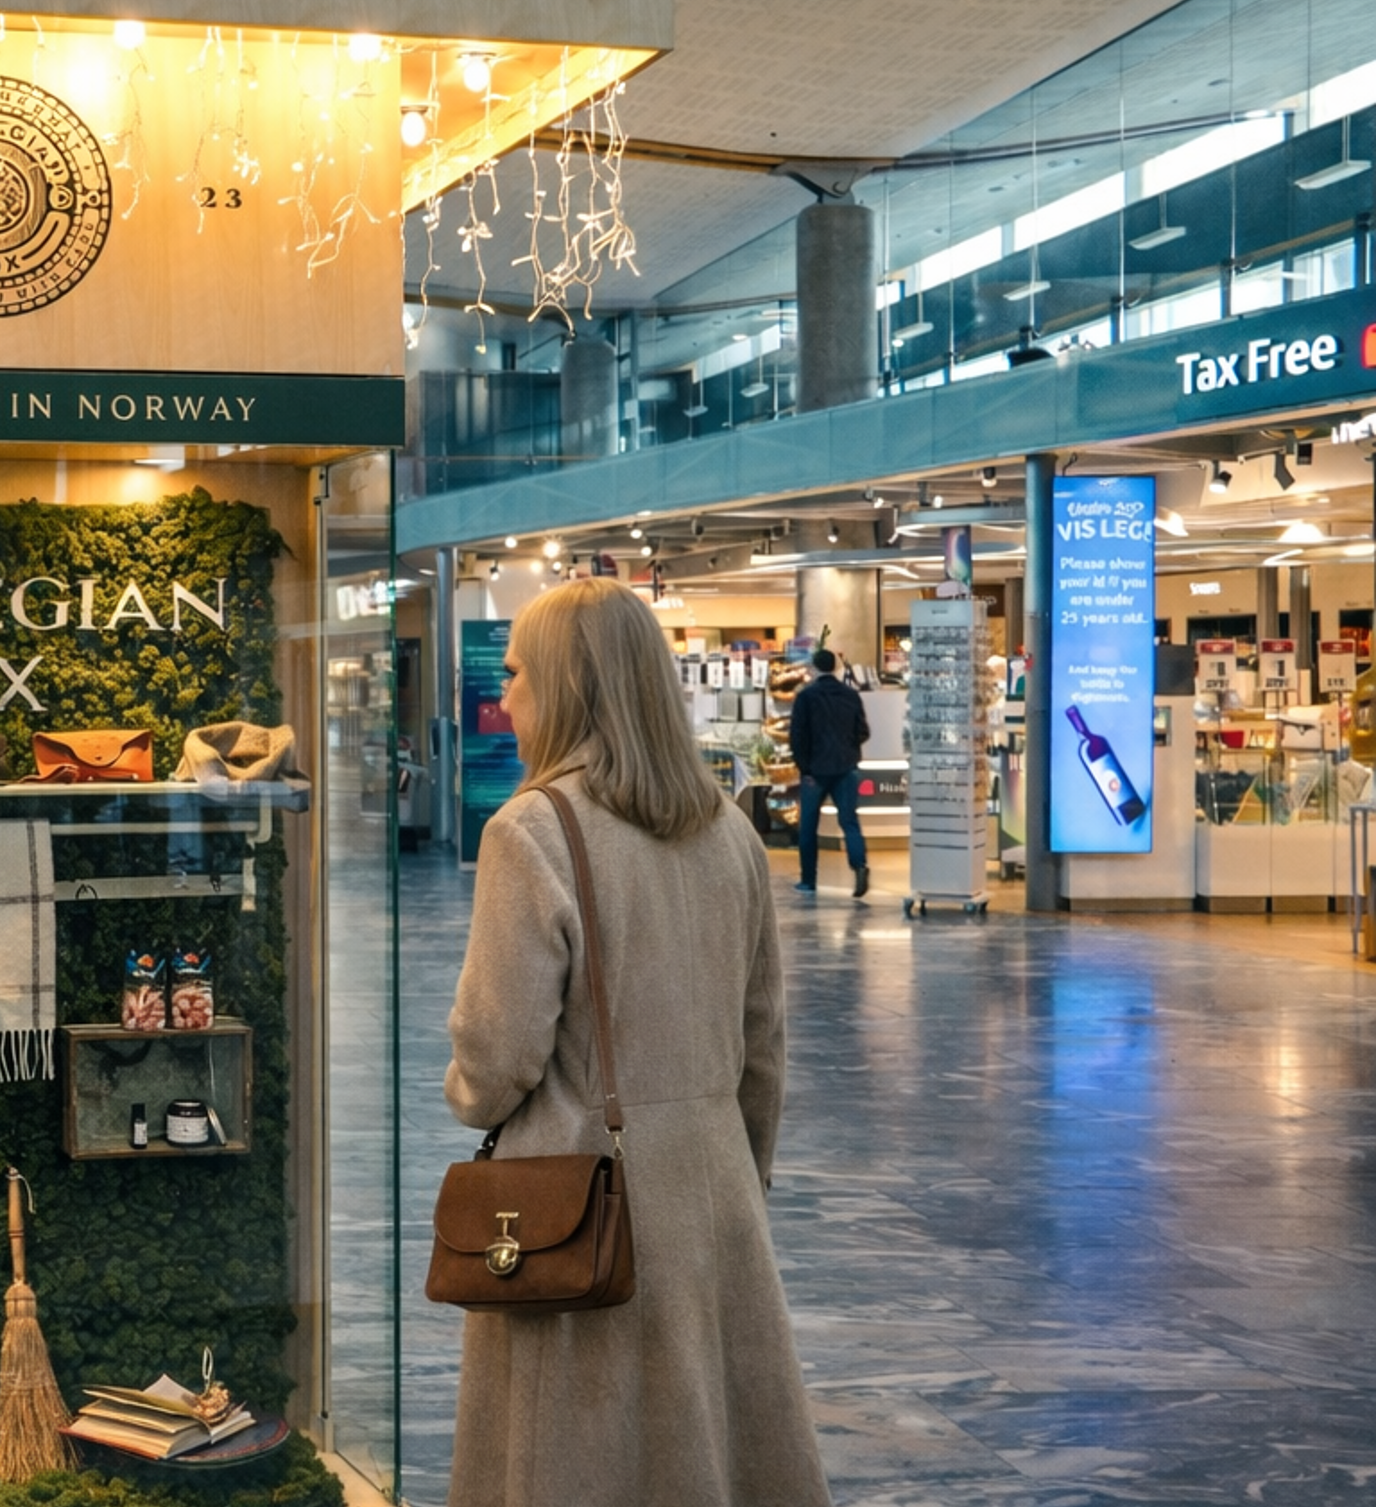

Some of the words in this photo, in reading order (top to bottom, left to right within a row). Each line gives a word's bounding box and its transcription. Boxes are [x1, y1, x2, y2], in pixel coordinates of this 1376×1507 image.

[200, 187, 242, 209] 23
[1176, 351, 1239, 395] Tax
[1247, 333, 1338, 383] Free
[11, 392, 52, 420] IN
[78, 393, 256, 422] NORWAY
[1057, 520, 1096, 541] VIS
